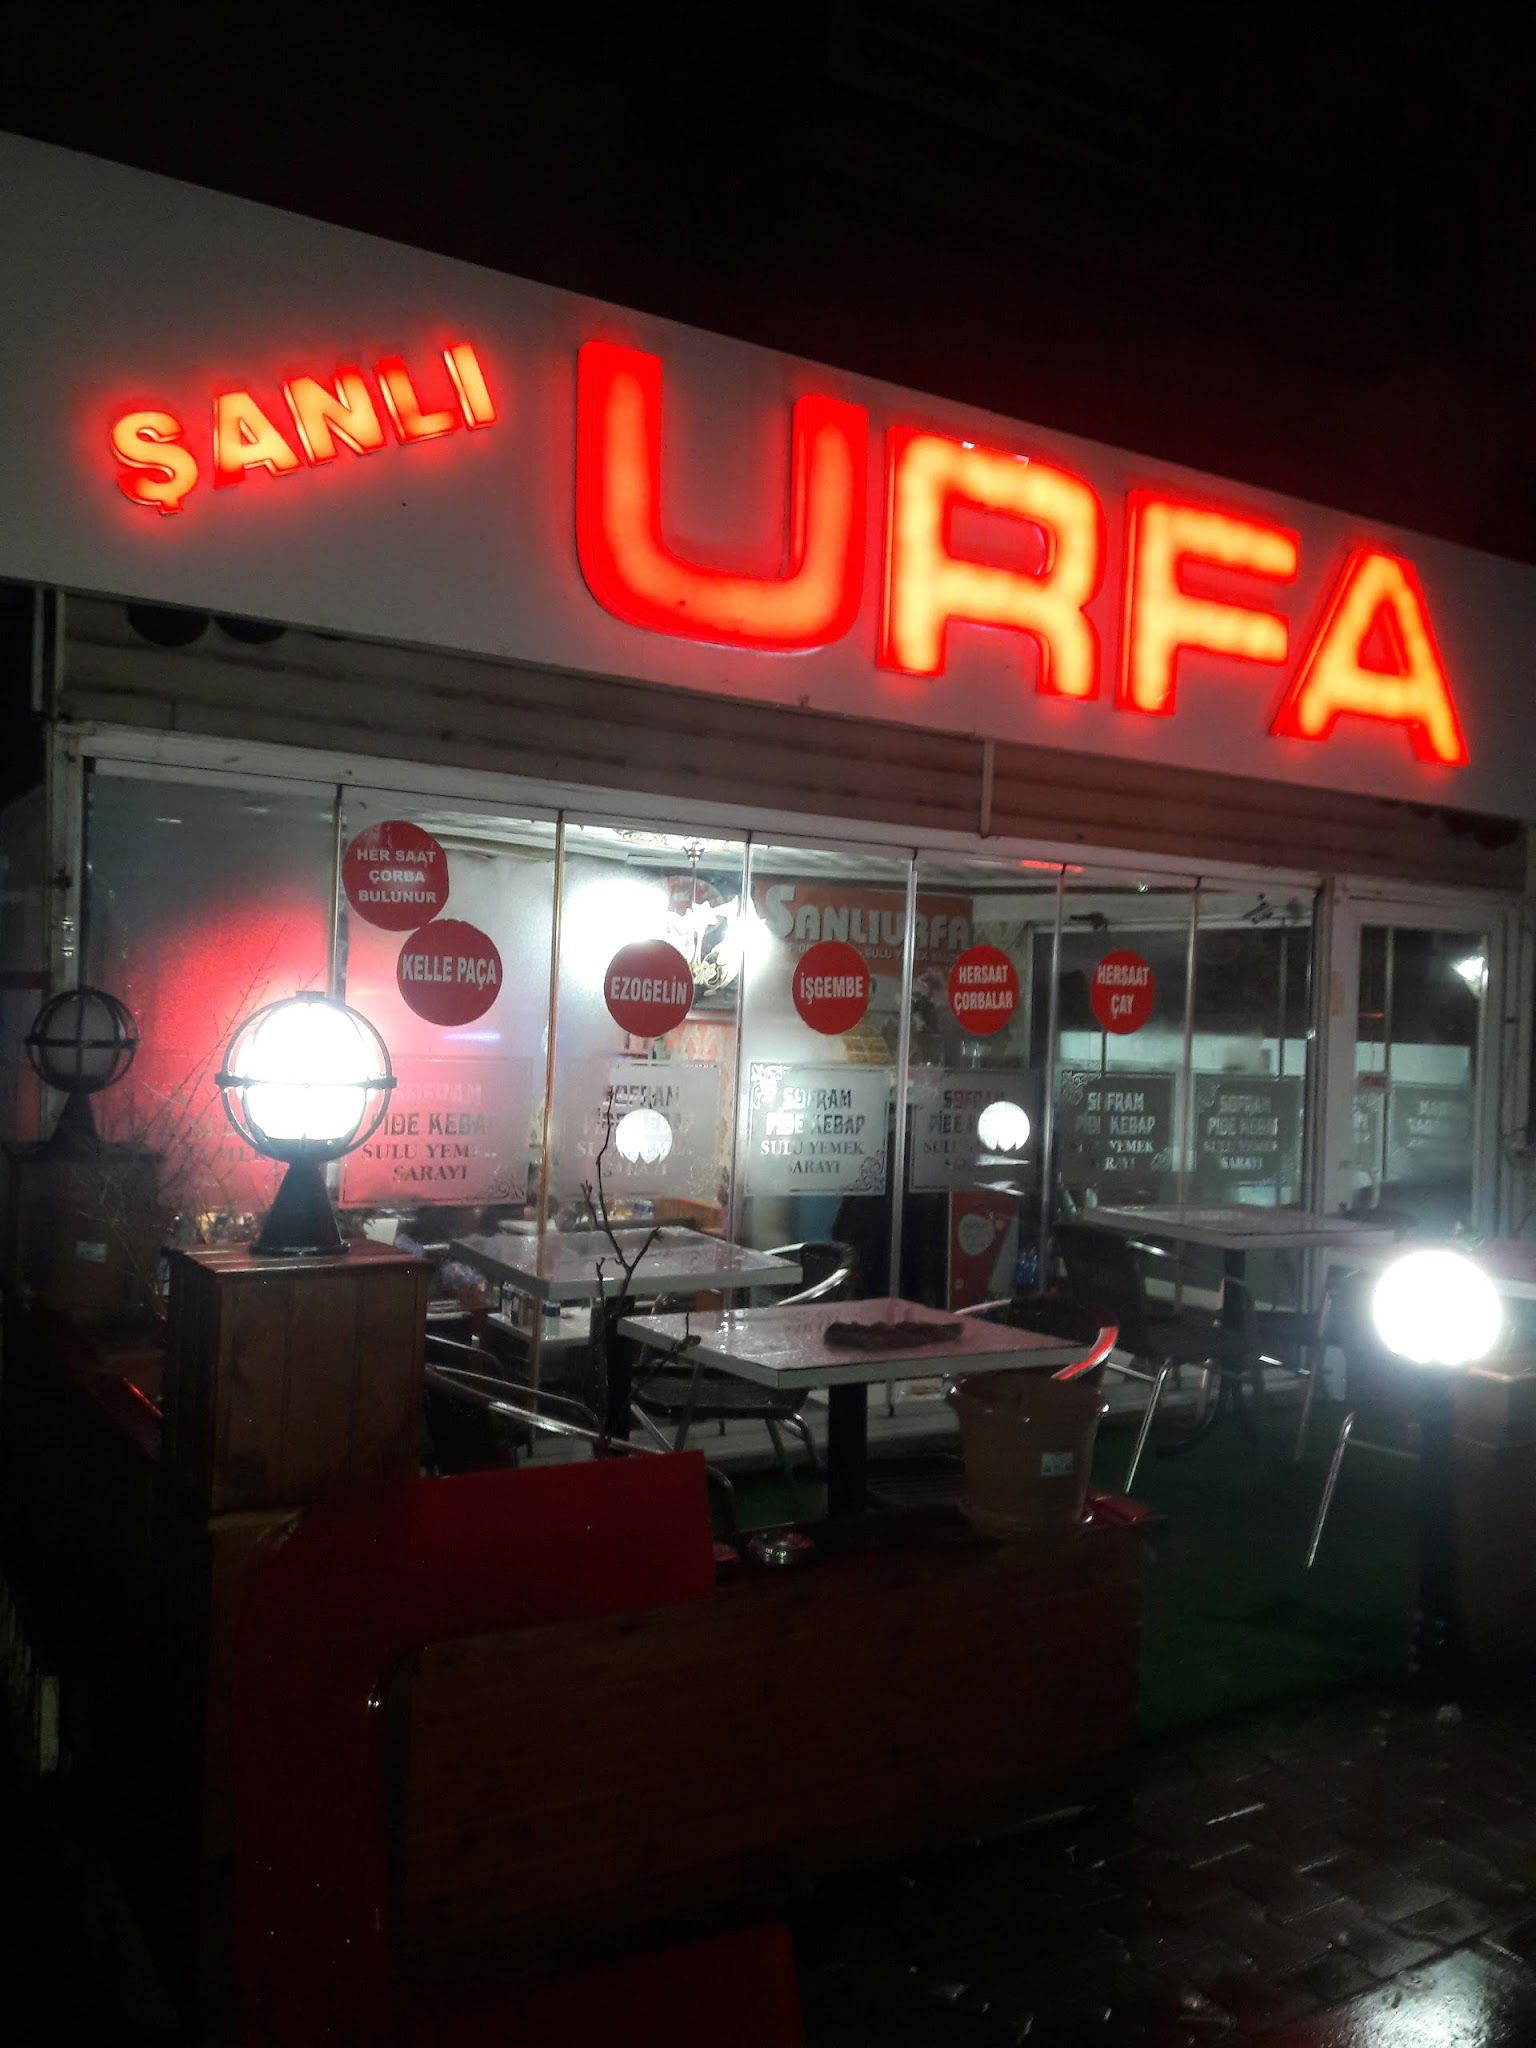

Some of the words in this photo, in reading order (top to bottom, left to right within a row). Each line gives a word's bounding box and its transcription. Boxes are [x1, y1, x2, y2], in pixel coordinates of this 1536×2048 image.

[110, 342, 497, 515] ŞANLI
[575, 340, 1470, 767] URFA
[356, 848, 390, 862] HER
[395, 850, 437, 864] SAAT
[368, 869, 426, 885] ÇORBA
[402, 954, 453, 982] KELLE
[456, 956, 497, 991] PAÇA
[958, 964, 1009, 985] HERSAAT
[1096, 964, 1150, 987] HERSAAT
[610, 975, 688, 1005] EZOGELİN
[799, 971, 864, 1005] İŞGEMBE
[953, 990, 1014, 1016] ÇORBALAR
[1110, 994, 1135, 1020] ÇAY
[809, 1141, 865, 1156] YEMEK
[788, 1160, 841, 1175] ARAYI
